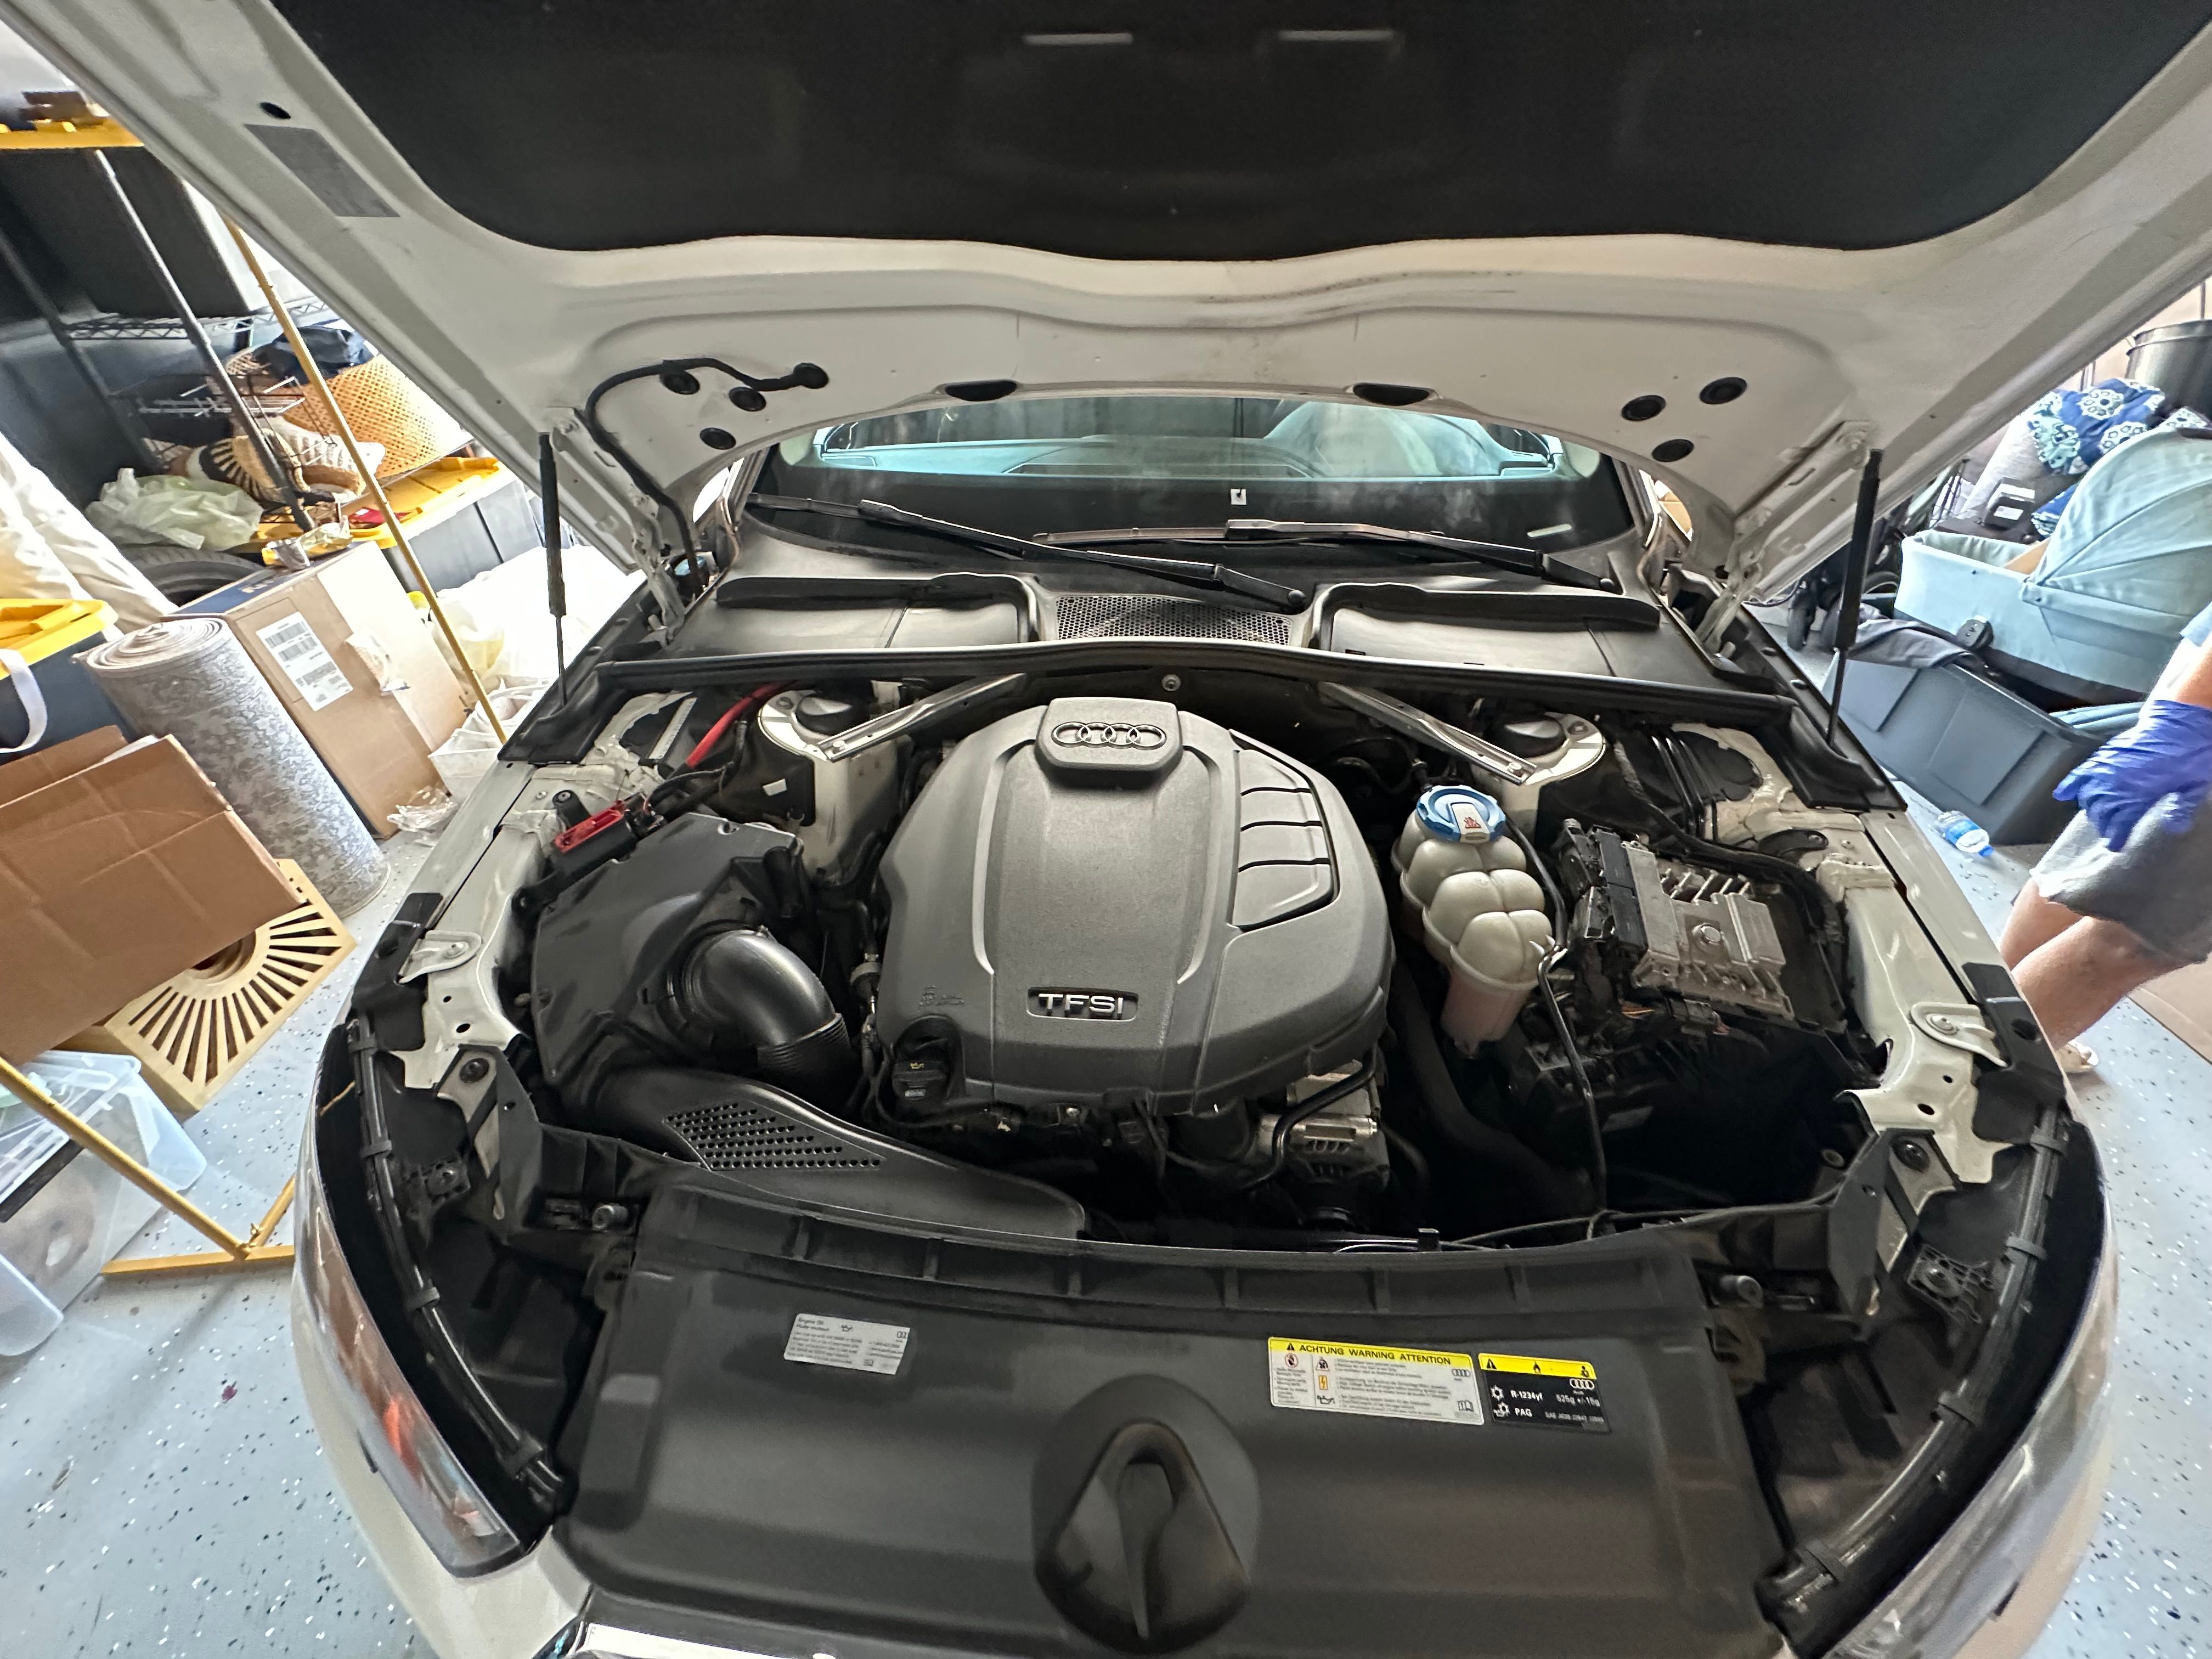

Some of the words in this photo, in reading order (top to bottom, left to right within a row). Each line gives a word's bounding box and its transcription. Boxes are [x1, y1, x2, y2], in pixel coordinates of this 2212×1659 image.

[1038, 993, 1124, 1014] TFSI
[1299, 1344, 1344, 1355] ACHTUNG
[1348, 1348, 1395, 1359] WARNING
[1400, 1353, 1451, 1365] ATTENTION
[1510, 1390, 1543, 1402] R-1234yf
[1514, 1408, 1532, 1417] PAG
